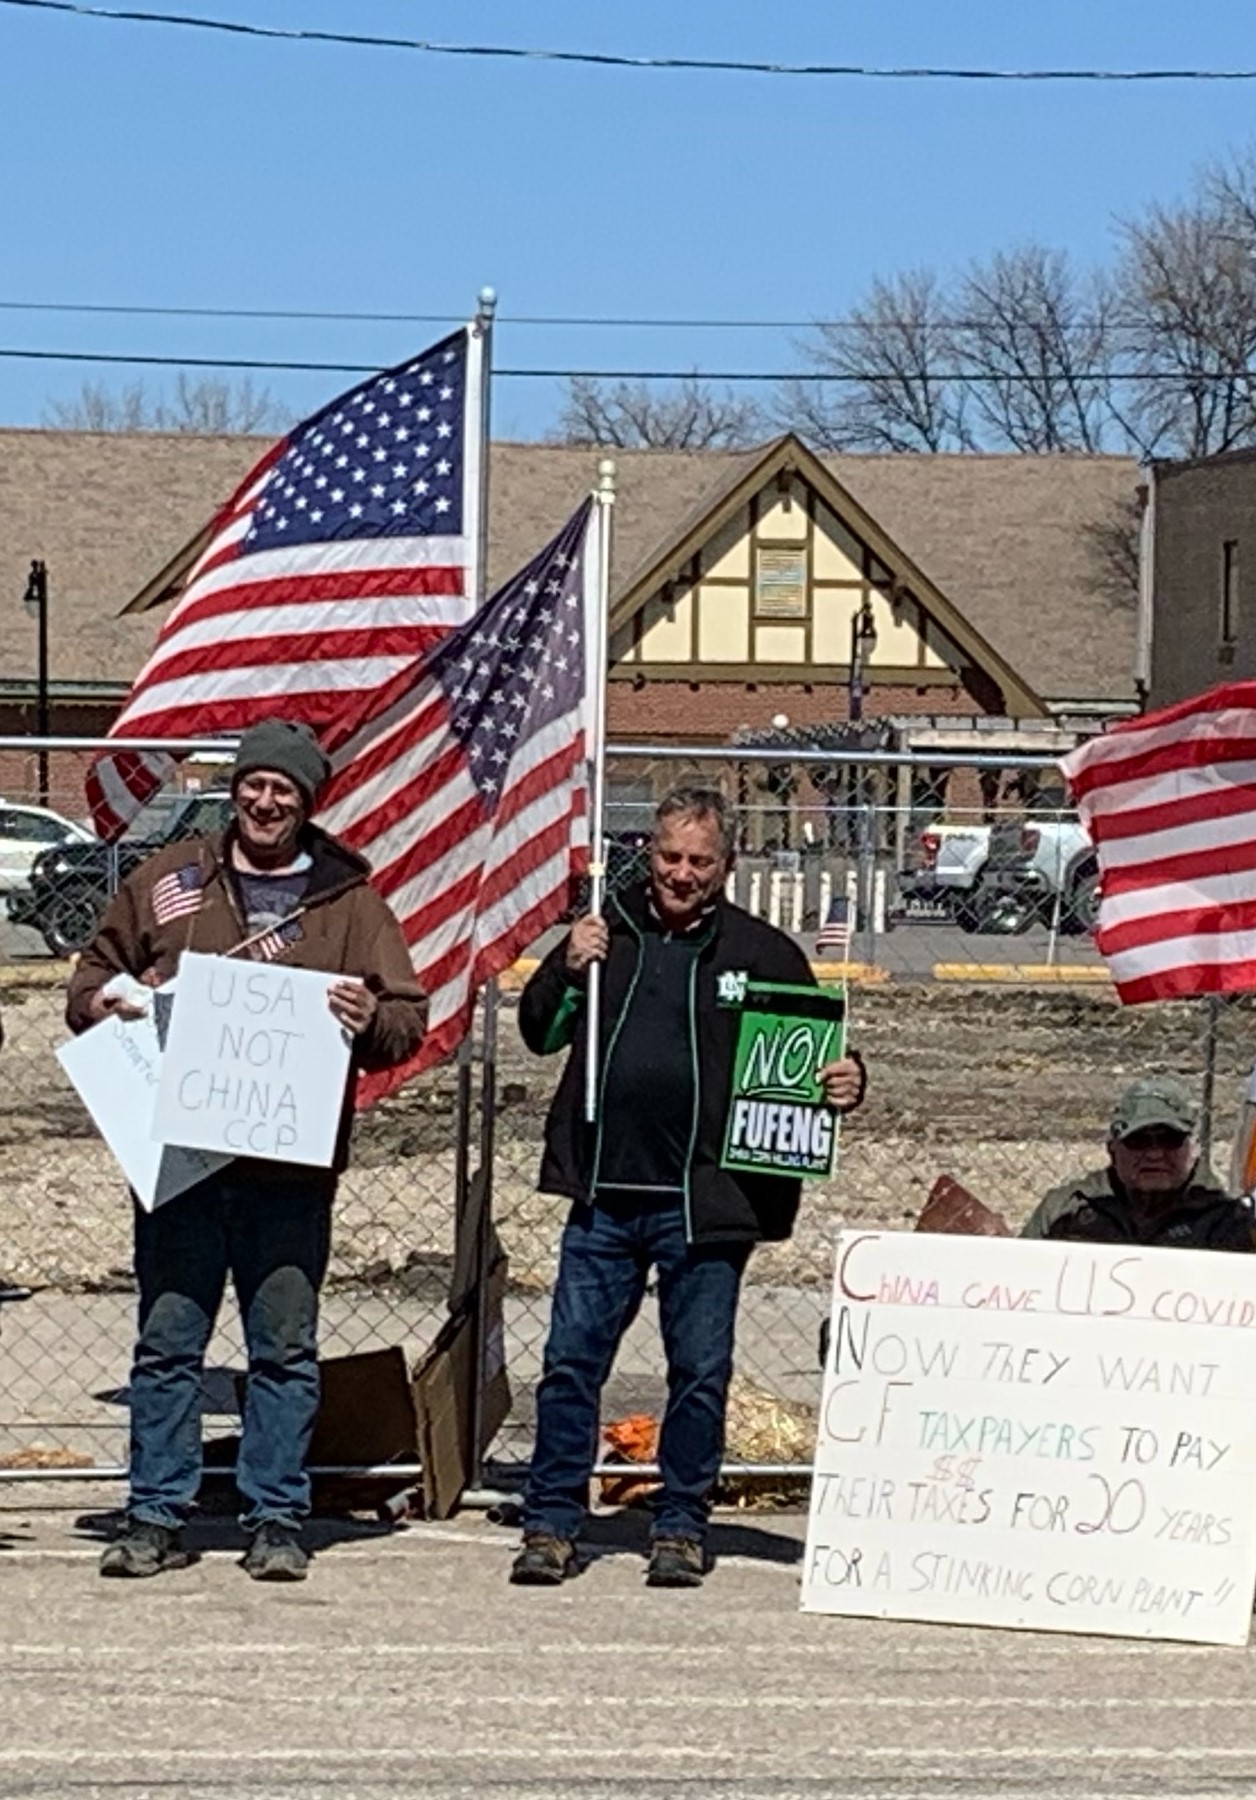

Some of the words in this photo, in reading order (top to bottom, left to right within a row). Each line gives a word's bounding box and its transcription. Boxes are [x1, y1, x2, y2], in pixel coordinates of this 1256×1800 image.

[208, 970, 295, 1017] USA
[218, 1023, 305, 1068] NOT
[741, 1020, 836, 1090] NO!
[177, 1070, 297, 1124] CHINA
[223, 1119, 298, 1155] CCP
[731, 1099, 833, 1157] FUFENG
[1055, 1257, 1143, 1317] US
[834, 1305, 960, 1376] NOW
[1098, 1355, 1221, 1398] WANT
[918, 1410, 1101, 1462] TAXPAYERS
[1119, 1426, 1158, 1465] TO
[1168, 1431, 1232, 1471] PAY
[907, 1481, 994, 1525] TAXES
[1010, 1492, 1070, 1533] FOR
[1074, 1472, 1147, 1535] 20
[1153, 1506, 1234, 1546] YEARS
[808, 1545, 862, 1588] FOR
[872, 1551, 892, 1590] A
[907, 1551, 1034, 1602] STINKING
[1046, 1571, 1125, 1606] CORN
